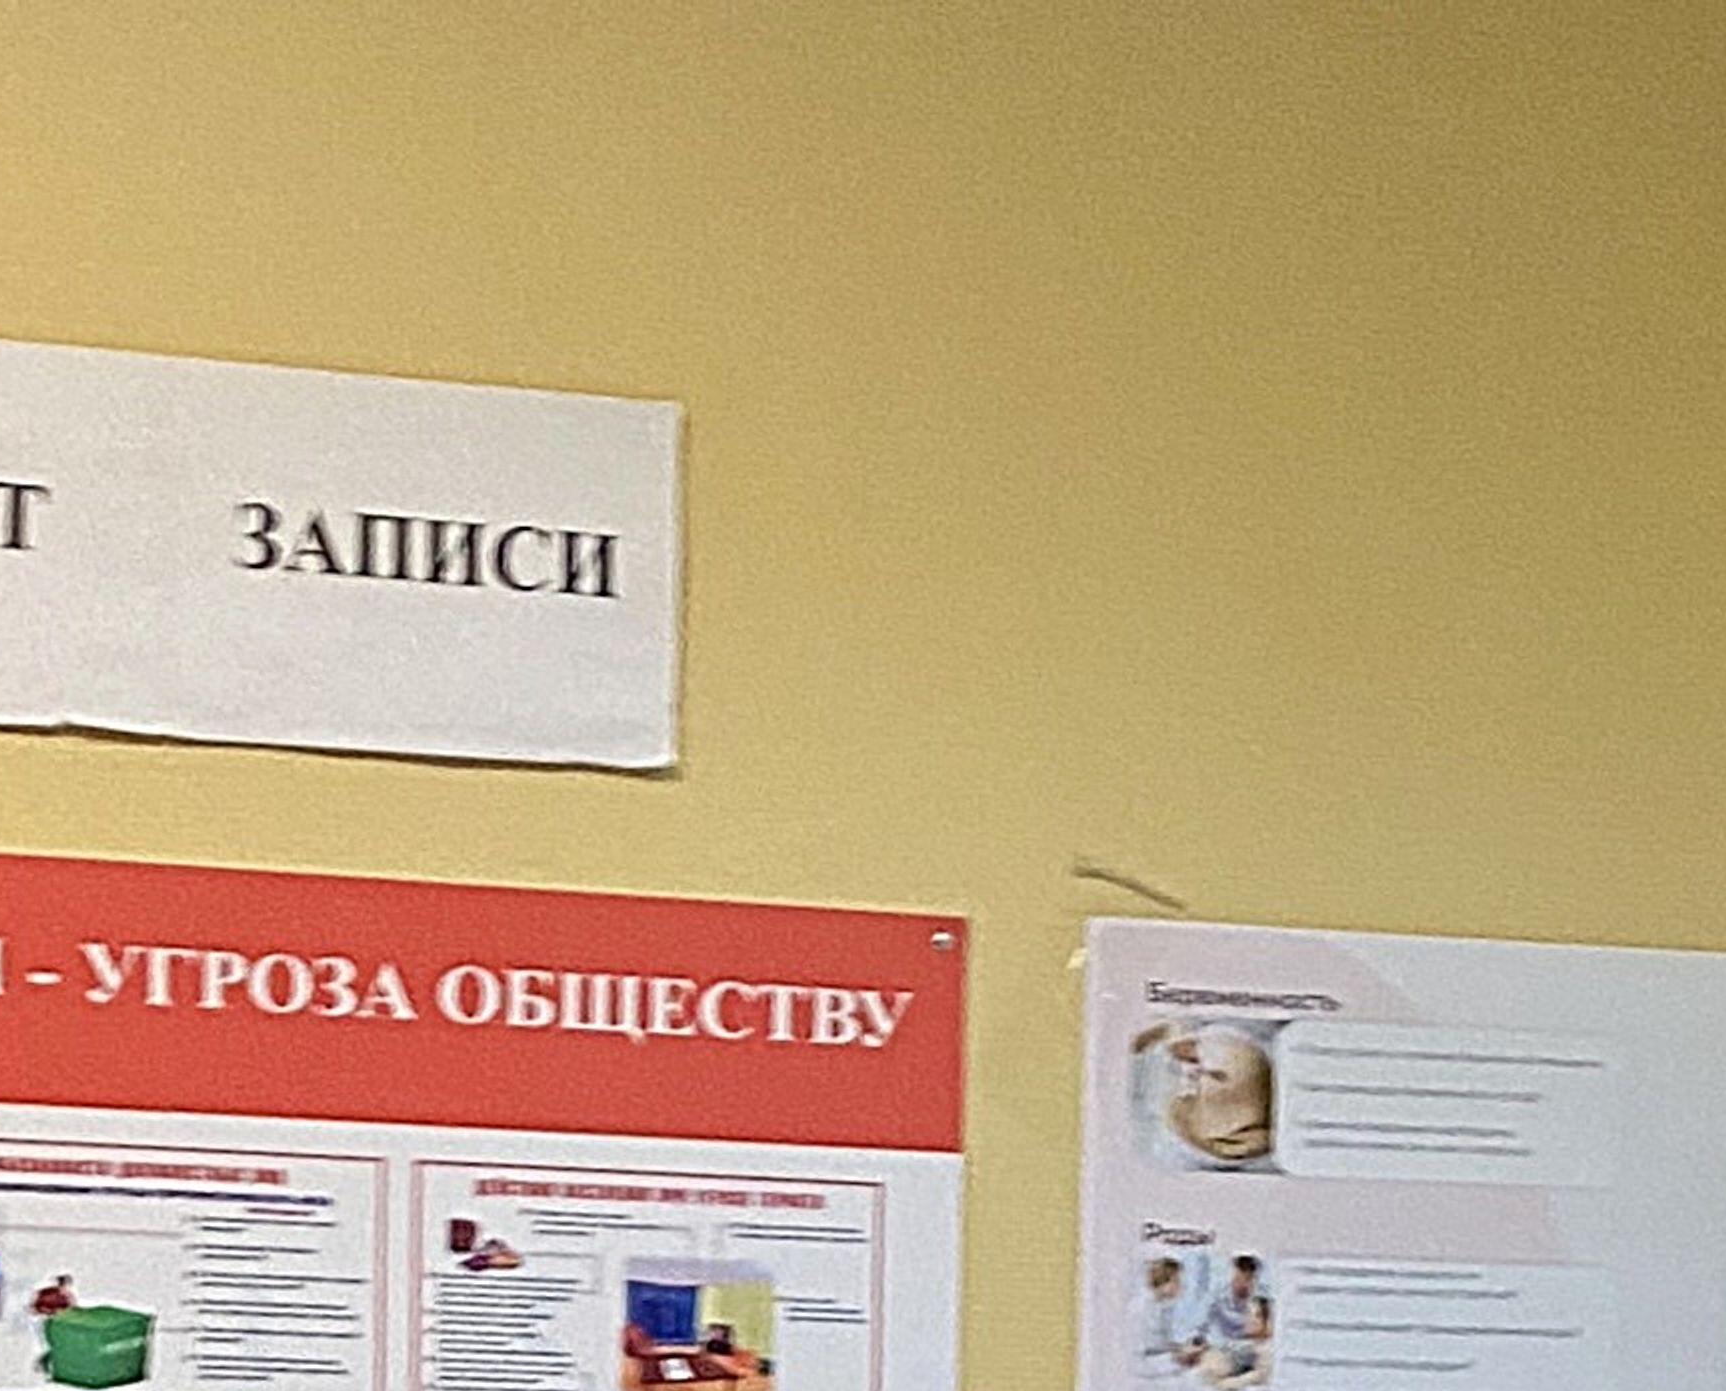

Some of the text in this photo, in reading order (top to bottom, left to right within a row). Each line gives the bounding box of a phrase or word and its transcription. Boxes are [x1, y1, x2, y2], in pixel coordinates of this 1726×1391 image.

[232, 502, 621, 599] ЗАПИСИ
[82, 942, 419, 1024] УГРОЗА
[434, 964, 914, 1048] ОБЩЕСТВУ
